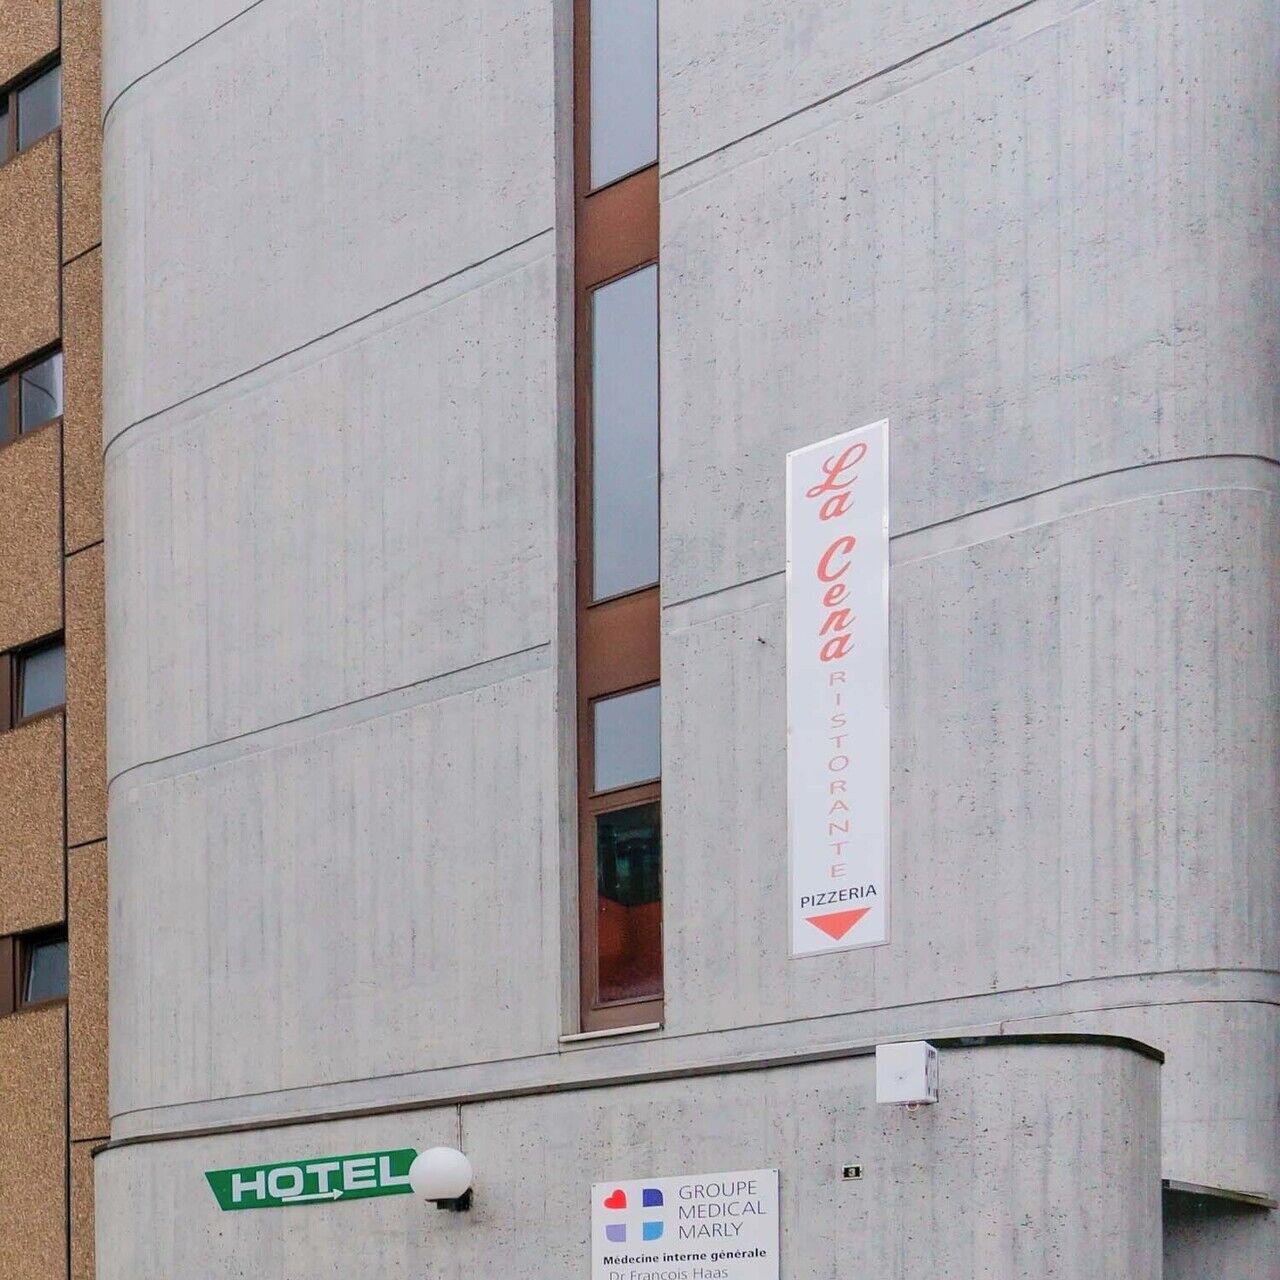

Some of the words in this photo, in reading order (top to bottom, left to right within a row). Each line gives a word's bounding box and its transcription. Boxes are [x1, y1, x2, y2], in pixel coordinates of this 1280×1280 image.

[805, 443, 868, 521] La
[817, 536, 857, 662] Cena
[828, 671, 850, 879] RISTORANTE
[800, 884, 877, 909] PIZZERIA
[231, 1155, 410, 1203] HOTEL
[679, 1181, 758, 1200] GROUPE
[678, 1200, 767, 1220] MEDICAL
[678, 1221, 744, 1240] MARLY
[603, 1252, 660, 1266] Médecine
[662, 1250, 708, 1263] interne
[710, 1247, 767, 1262] générale
[693, 1267, 729, 1280] Haas
